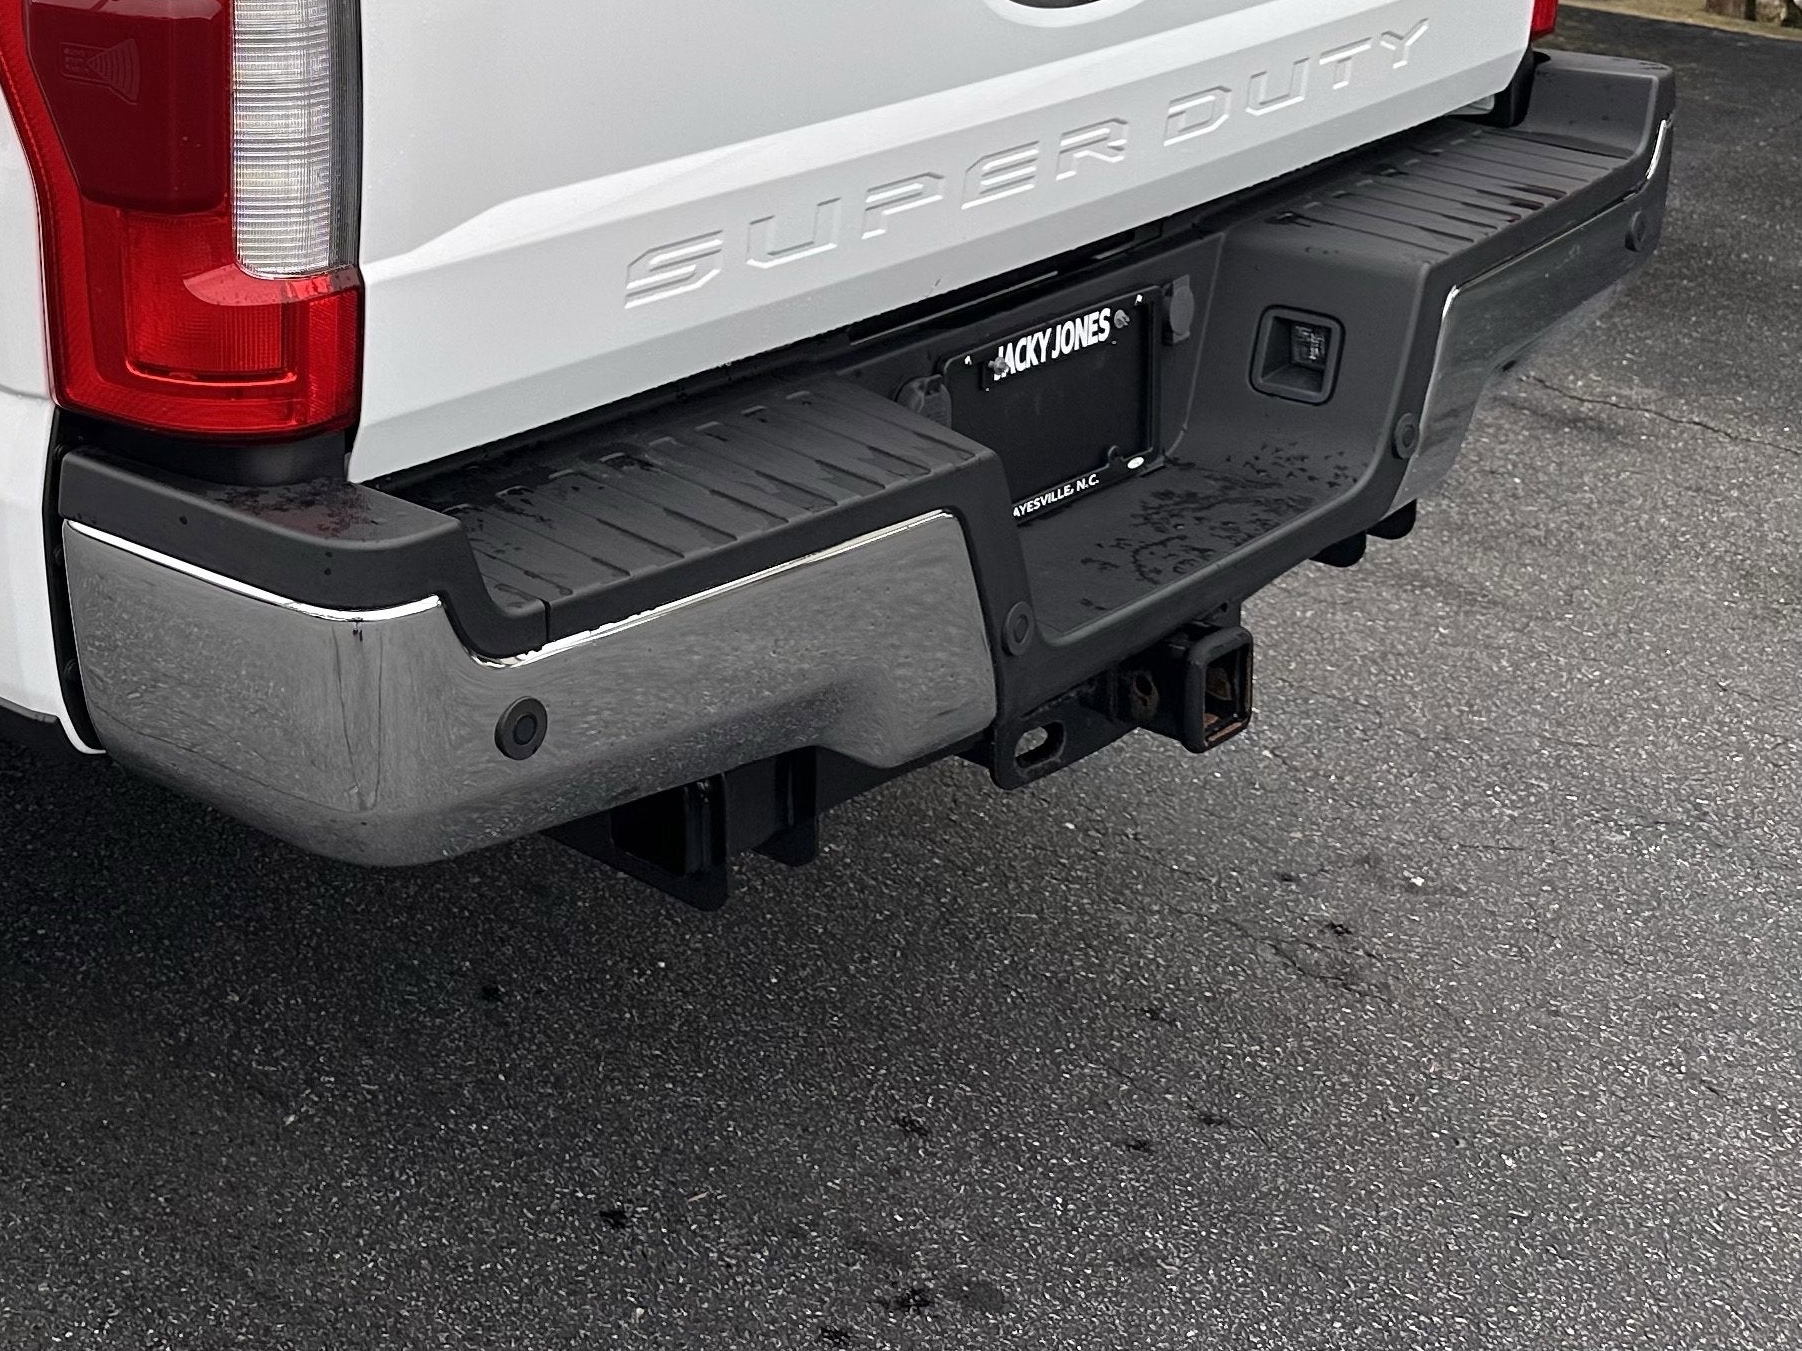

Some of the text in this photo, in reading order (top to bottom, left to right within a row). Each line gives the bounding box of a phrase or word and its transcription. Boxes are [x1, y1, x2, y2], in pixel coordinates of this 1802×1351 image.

[624, 17, 1431, 310] SUPER DUTY
[993, 307, 1111, 382] JACKY JONES
[1012, 484, 1075, 518] AYESVILLE,
